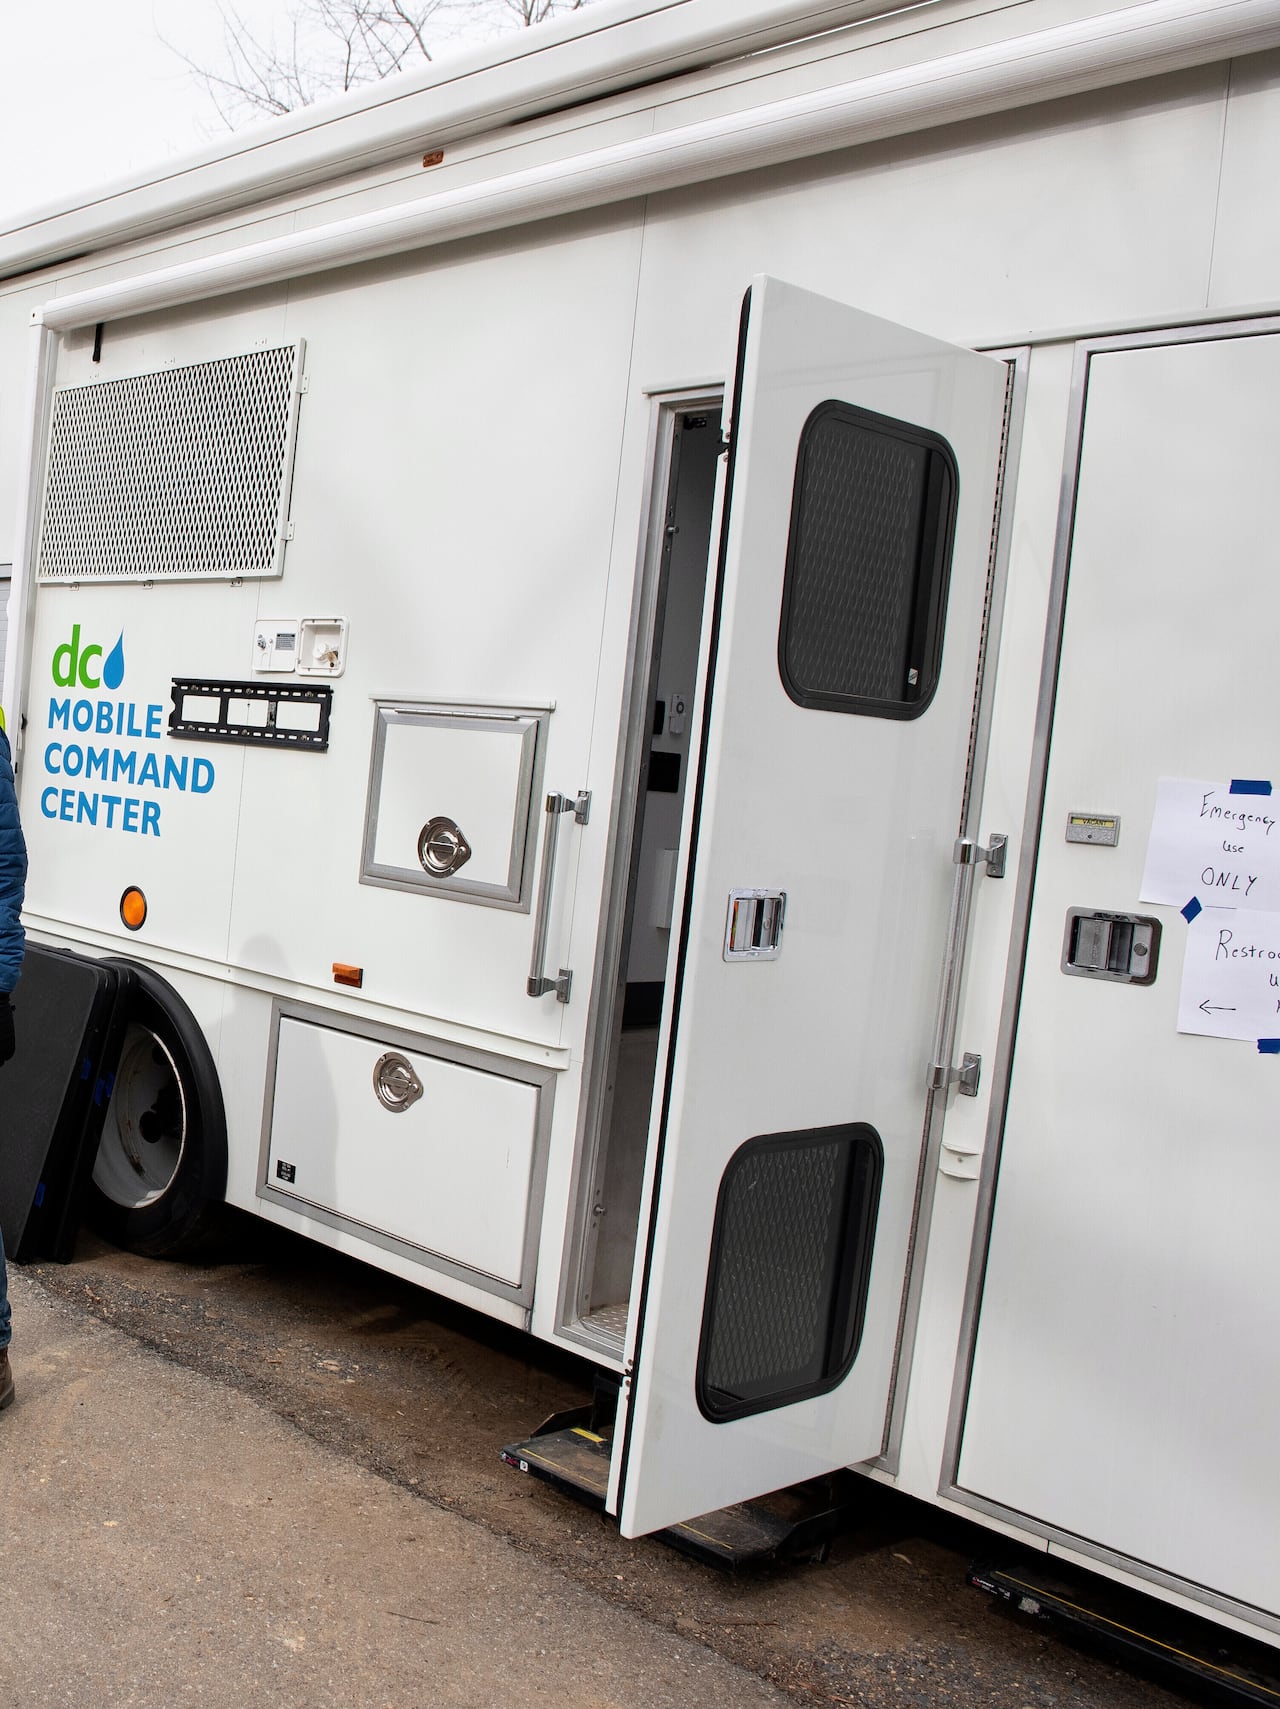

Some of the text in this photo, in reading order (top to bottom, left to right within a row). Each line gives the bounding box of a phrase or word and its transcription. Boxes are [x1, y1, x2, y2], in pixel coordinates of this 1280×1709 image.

[51, 624, 104, 689] dc
[47, 697, 164, 740] MOBILE
[43, 742, 216, 795] COMMAND
[40, 786, 162, 838] CENTER
[1199, 791, 1276, 836] Emergency
[1200, 866, 1258, 897] ONLY
